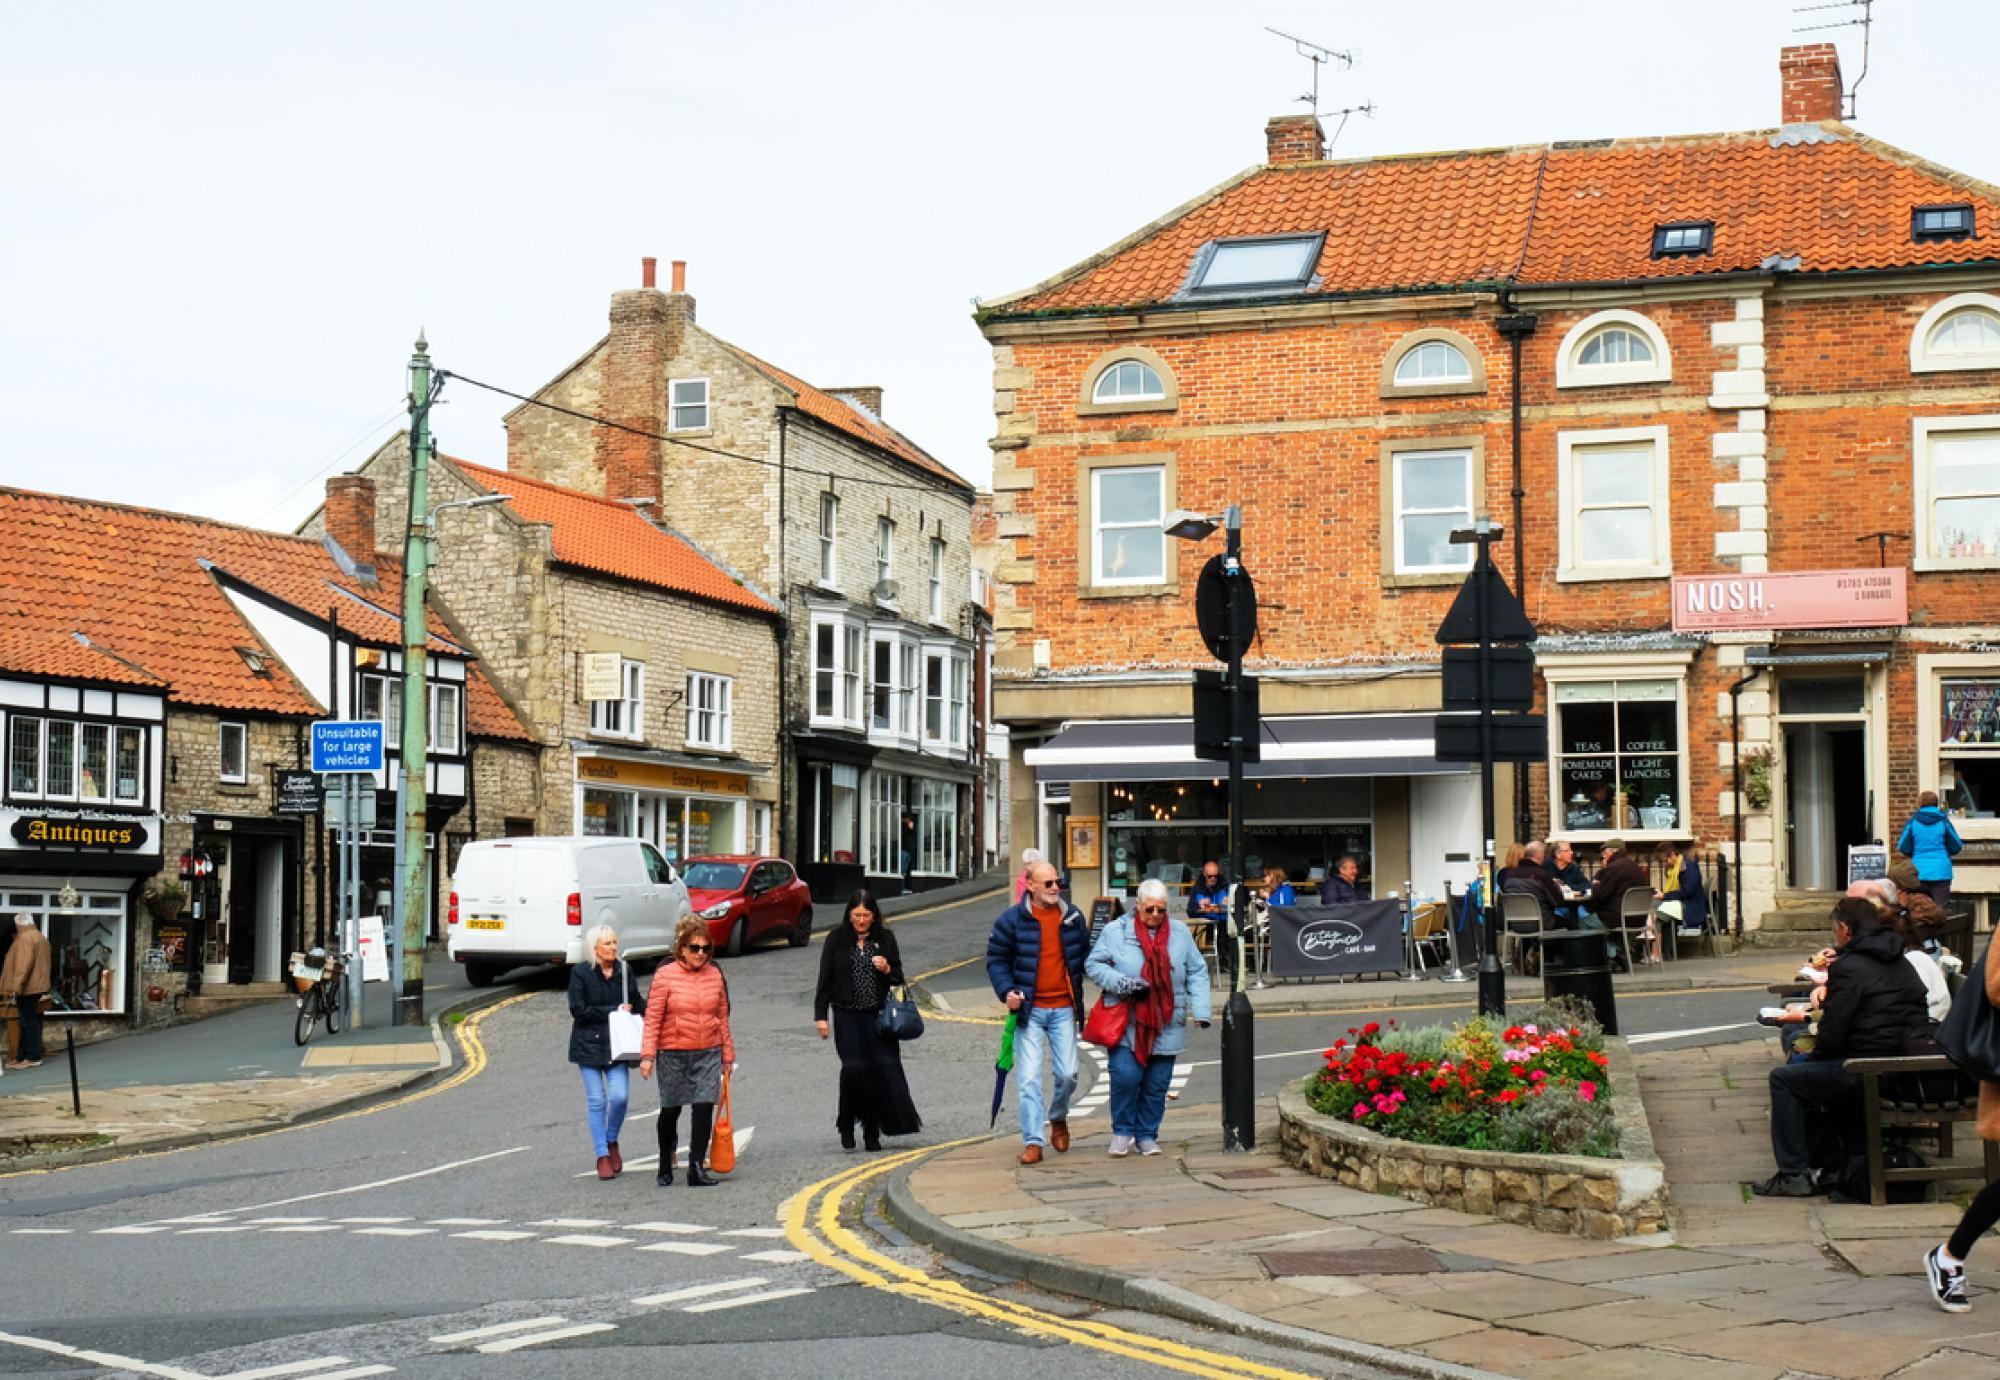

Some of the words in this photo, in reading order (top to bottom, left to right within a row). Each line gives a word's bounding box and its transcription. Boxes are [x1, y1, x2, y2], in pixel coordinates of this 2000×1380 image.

[318, 727, 379, 739] Unsuitable
[323, 741, 339, 752] for
[343, 741, 372, 753] large
[1574, 742, 1601, 752] TEAS
[1626, 741, 1666, 750] COFFEE
[325, 754, 370, 766] vehicles
[1631, 759, 1662, 768] LIGHT
[1571, 770, 1602, 780] CAKES
[1624, 768, 1671, 779] LUNCHES
[29, 820, 132, 845] Antiques
